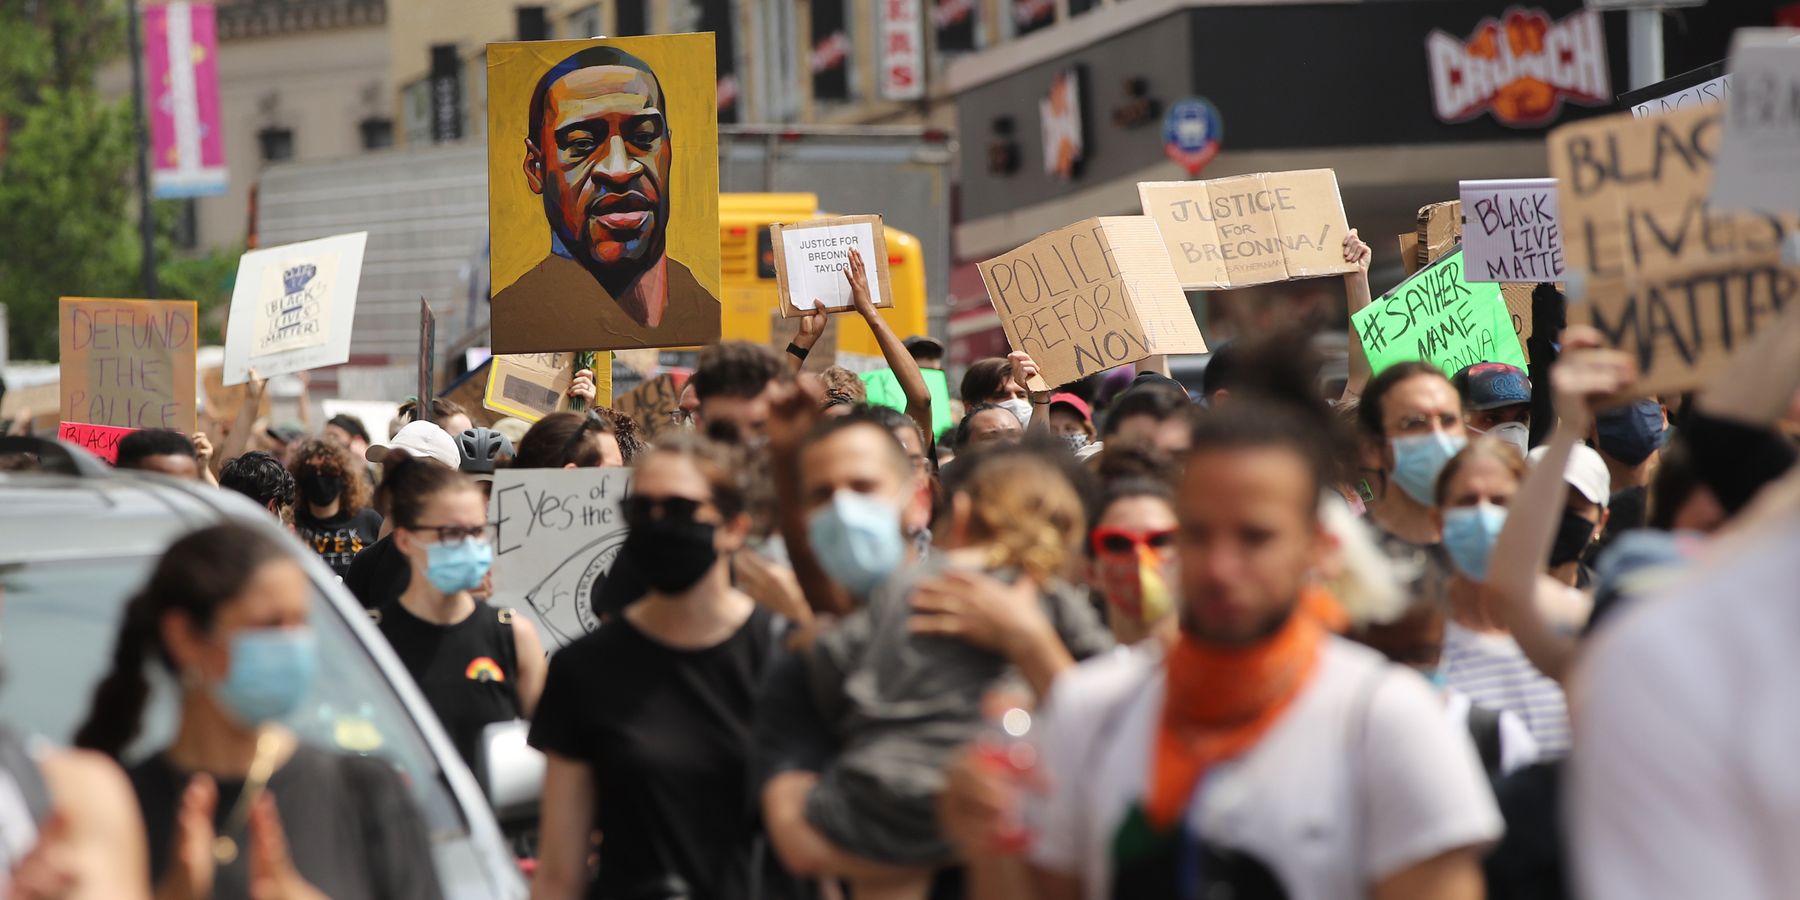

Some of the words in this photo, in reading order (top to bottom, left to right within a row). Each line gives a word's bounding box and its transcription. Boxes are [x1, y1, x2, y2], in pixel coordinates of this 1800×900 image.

[1567, 117, 1722, 197] BLAC
[1170, 188, 1297, 222] JUSTICE
[1474, 193, 1554, 236] BLACK
[800, 238, 838, 250] JUSTICE
[839, 236, 859, 246] FOR
[1180, 224, 1331, 264] BREONNA!
[1219, 222, 1257, 239] FOR
[1511, 224, 1559, 253] LIVE
[808, 249, 849, 262] BREONN
[990, 224, 1126, 315] POLICE
[1486, 248, 1566, 280] MATTE
[269, 288, 315, 314] BLACK
[72, 308, 190, 352] DEFUND
[264, 322, 315, 344] MATTER
[273, 307, 314, 329] LIVES
[1417, 301, 1478, 362] NAME
[94, 355, 160, 393] THE
[69, 391, 182, 430] POLICE
[65, 427, 120, 451] BLACK
[496, 483, 579, 555] Eyes
[589, 475, 610, 501] of
[579, 506, 613, 527] the
